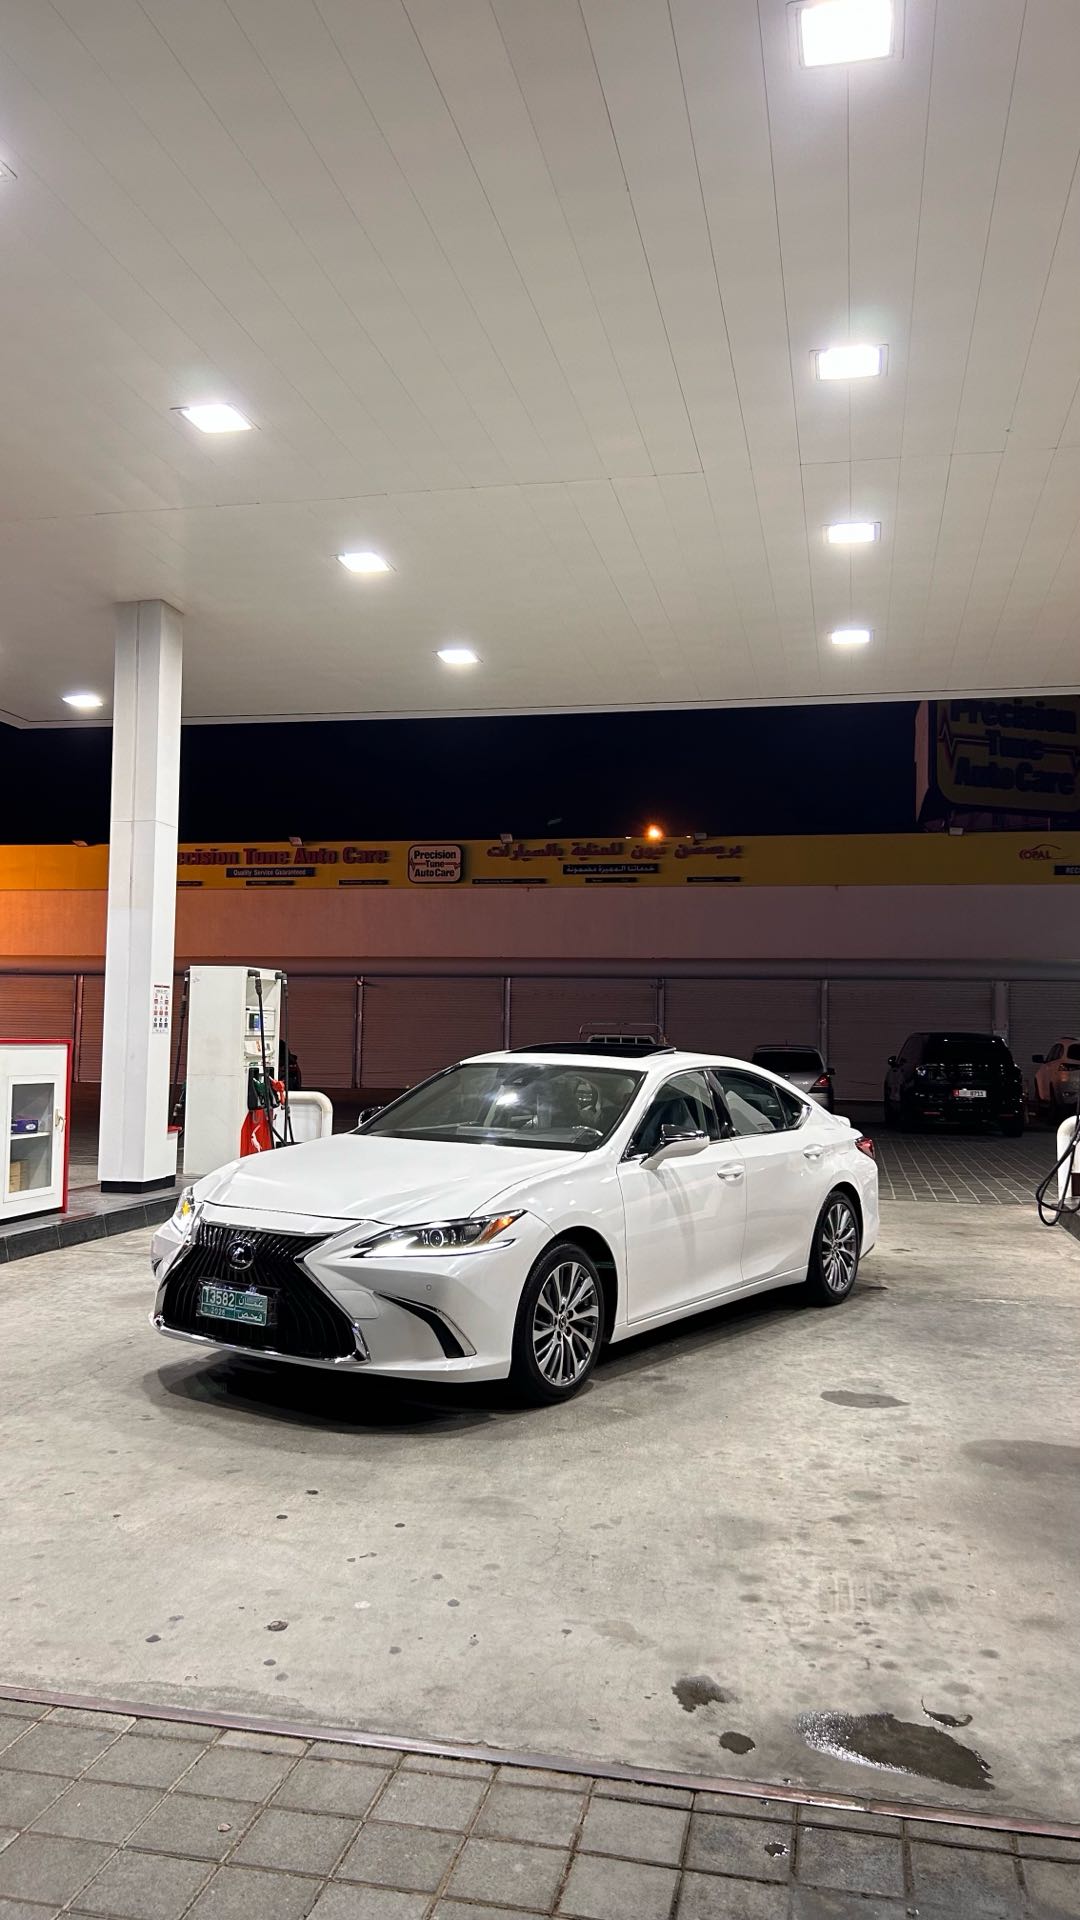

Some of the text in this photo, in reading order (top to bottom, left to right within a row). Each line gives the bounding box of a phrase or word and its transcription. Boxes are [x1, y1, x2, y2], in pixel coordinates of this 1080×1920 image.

[986, 730, 1043, 760] Tune
[955, 757, 1074, 794] Auto Care
[177, 847, 388, 865] ecision Tune Auto Care
[414, 850, 456, 859] Precision
[233, 869, 252, 877] Quality
[274, 868, 306, 876] Guaranteed
[415, 869, 434, 877] Auto
[205, 1288, 235, 1308] 13582
